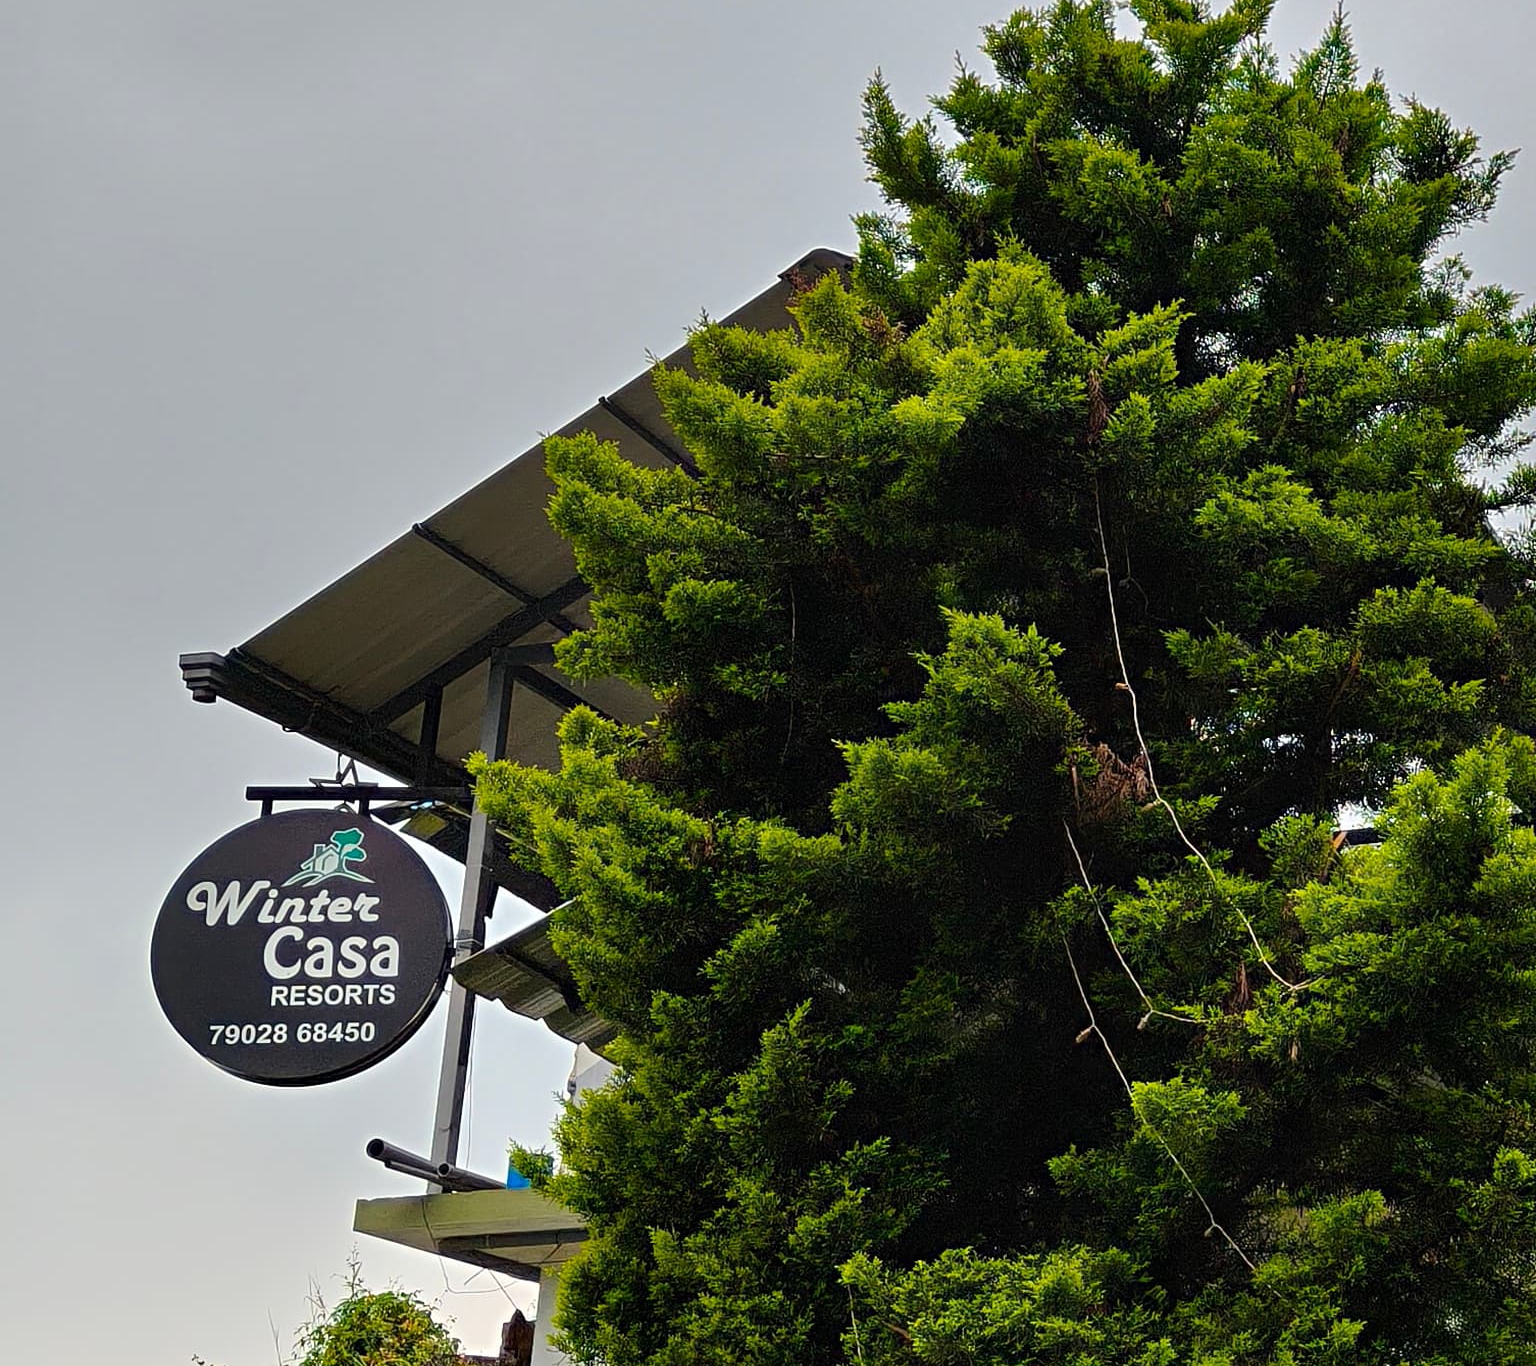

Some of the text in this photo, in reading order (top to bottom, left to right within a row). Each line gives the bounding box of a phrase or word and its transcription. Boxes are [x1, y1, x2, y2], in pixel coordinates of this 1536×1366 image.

[186, 880, 380, 926] Winter
[264, 926, 400, 980] Casa
[270, 984, 396, 1006] RESORTS
[209, 1022, 376, 1045] 79028 68450
